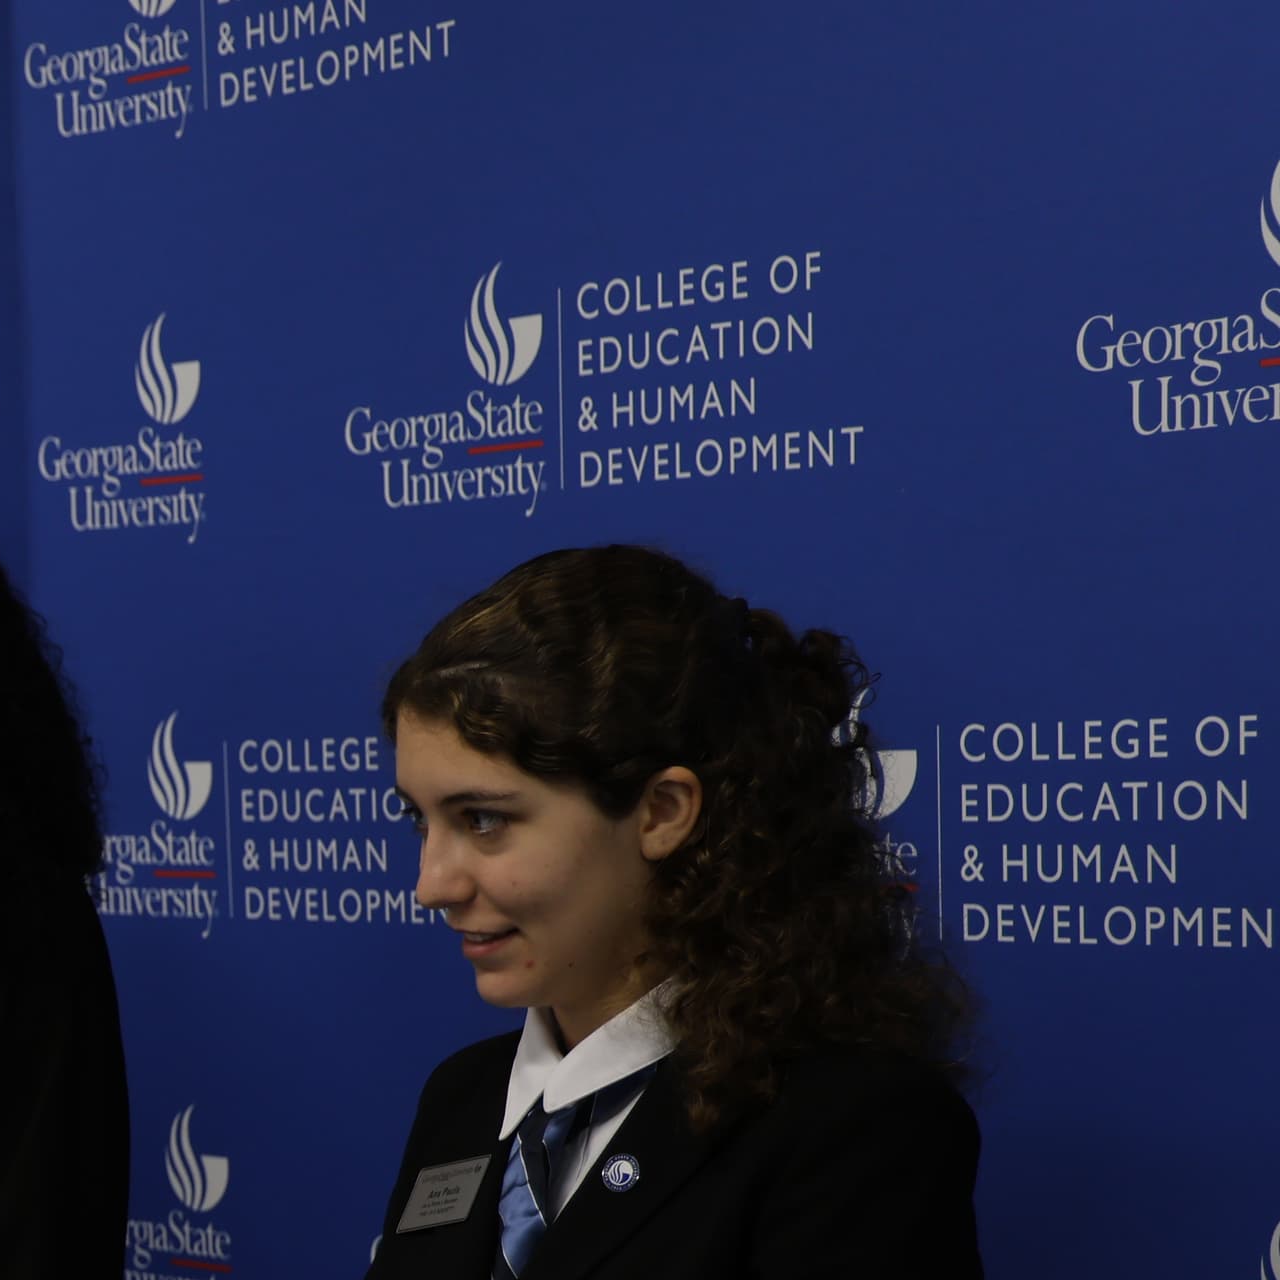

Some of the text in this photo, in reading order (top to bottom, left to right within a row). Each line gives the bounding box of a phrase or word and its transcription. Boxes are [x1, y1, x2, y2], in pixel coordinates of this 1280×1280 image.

[217, 0, 366, 56] & HUMAN
[219, 20, 456, 108] DEVELOPMENT
[55, 83, 193, 140] University
[576, 251, 822, 320] COLLEGE OF
[578, 312, 814, 377] EDUCATION
[578, 376, 756, 433] & HUMAN
[1128, 375, 1280, 436] Unive
[580, 425, 865, 488] DEVELOPMENT
[381, 455, 546, 518] University
[68, 486, 206, 545] University
[239, 736, 380, 774] COLLEGE
[959, 714, 1258, 763] COLLEGE OF
[240, 787, 408, 823] EDUCATIO
[961, 779, 1248, 823] EDUCATION
[102, 819, 216, 885] rgiaState
[241, 838, 388, 873] & HUMAN
[960, 844, 985, 883] &
[1001, 843, 1177, 884] HUMAN
[245, 886, 448, 925] DEVELOPME
[962, 903, 1273, 949] DEVELOPMEN
[125, 1209, 232, 1270] rgiaState
